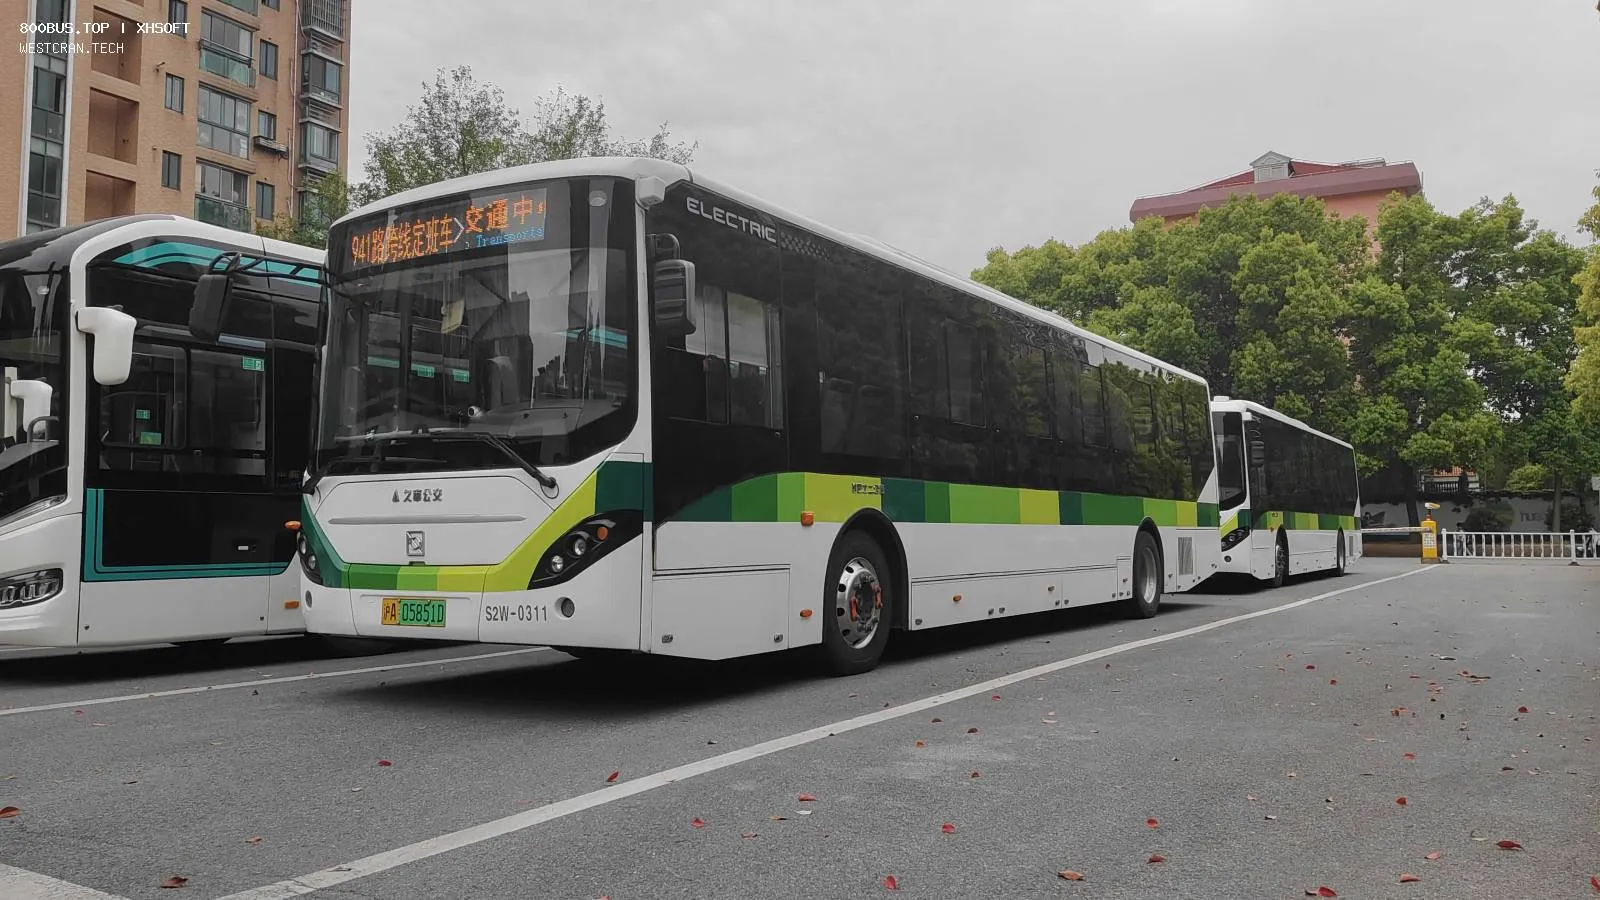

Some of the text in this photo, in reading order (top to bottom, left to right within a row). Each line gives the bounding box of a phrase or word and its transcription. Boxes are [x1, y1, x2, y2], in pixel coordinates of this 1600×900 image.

[686, 196, 777, 244] ELECTRIC
[404, 488, 442, 502] 久事公交
[485, 605, 548, 622] S2W-0311
